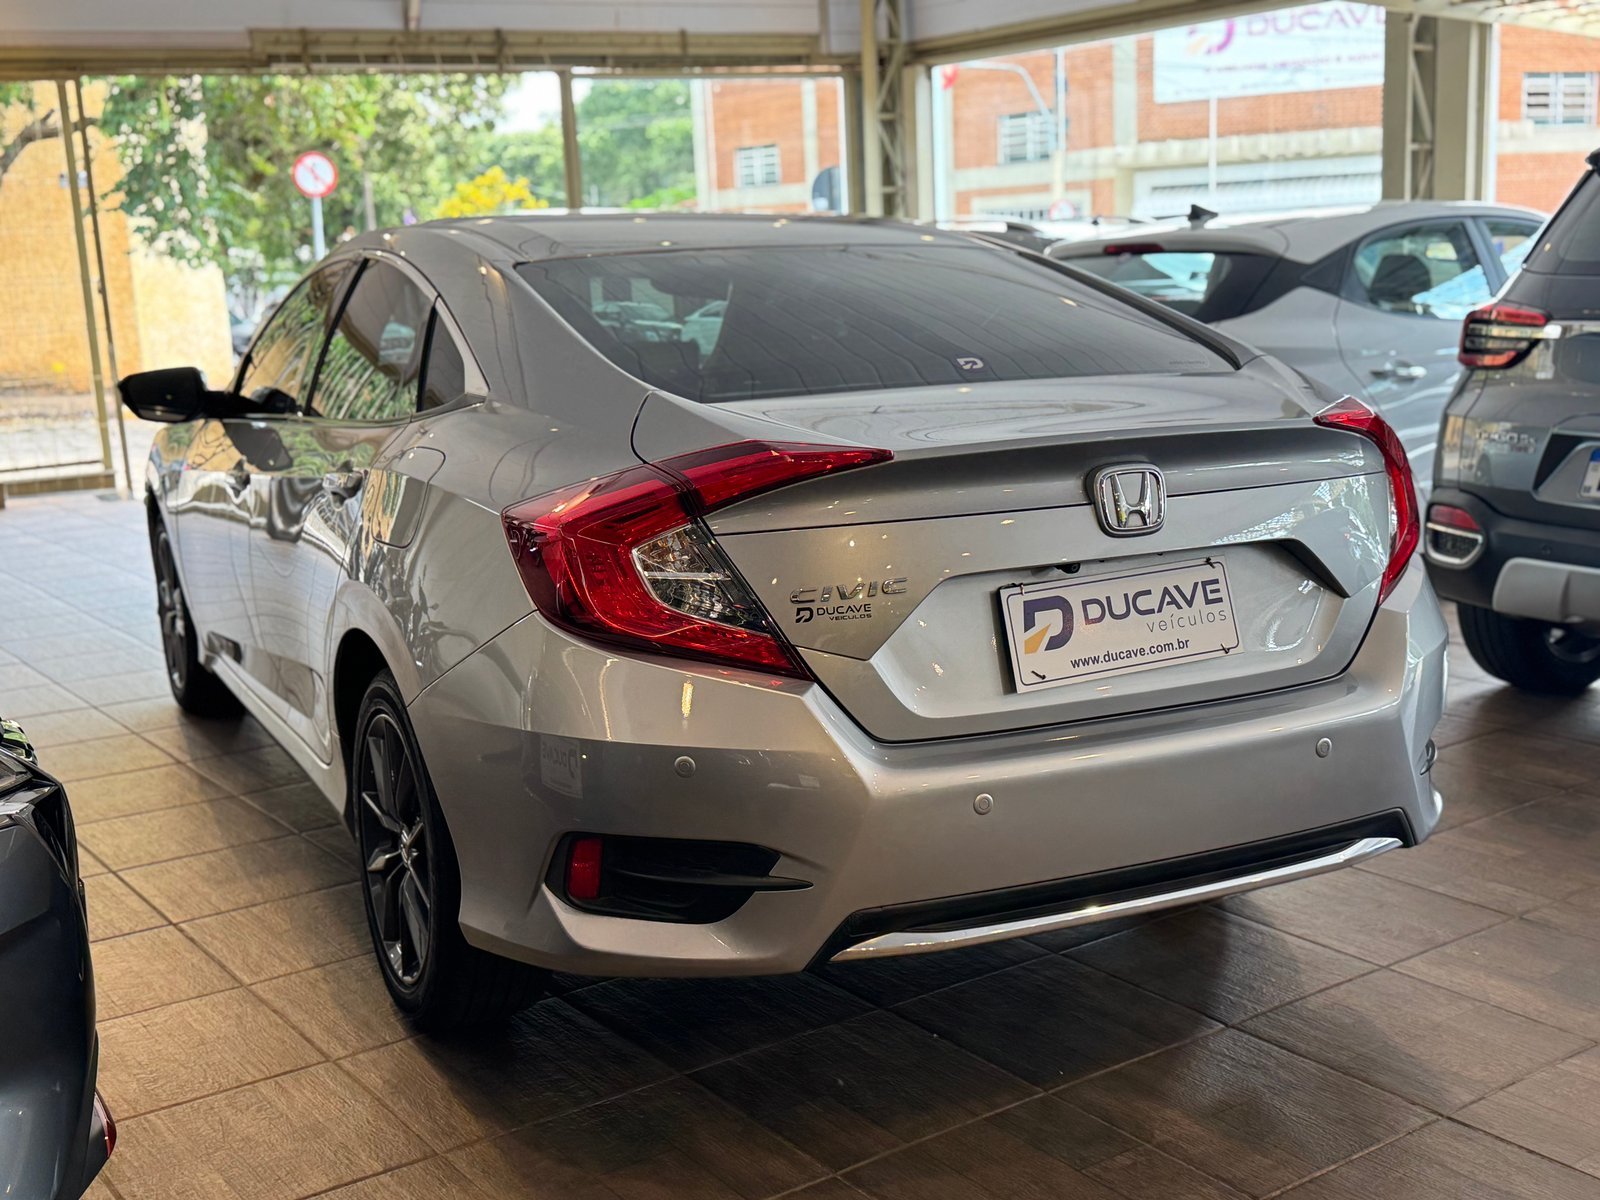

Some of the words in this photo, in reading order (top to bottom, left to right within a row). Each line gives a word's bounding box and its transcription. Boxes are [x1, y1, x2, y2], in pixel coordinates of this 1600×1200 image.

[789, 577, 908, 604] CIVIC
[1081, 578, 1224, 626] DUCAVE
[816, 603, 872, 616] DUCAVE
[829, 613, 872, 621] VEICULOS
[1146, 609, 1227, 633] veículos
[1070, 638, 1190, 669] www.ducave.com.br
